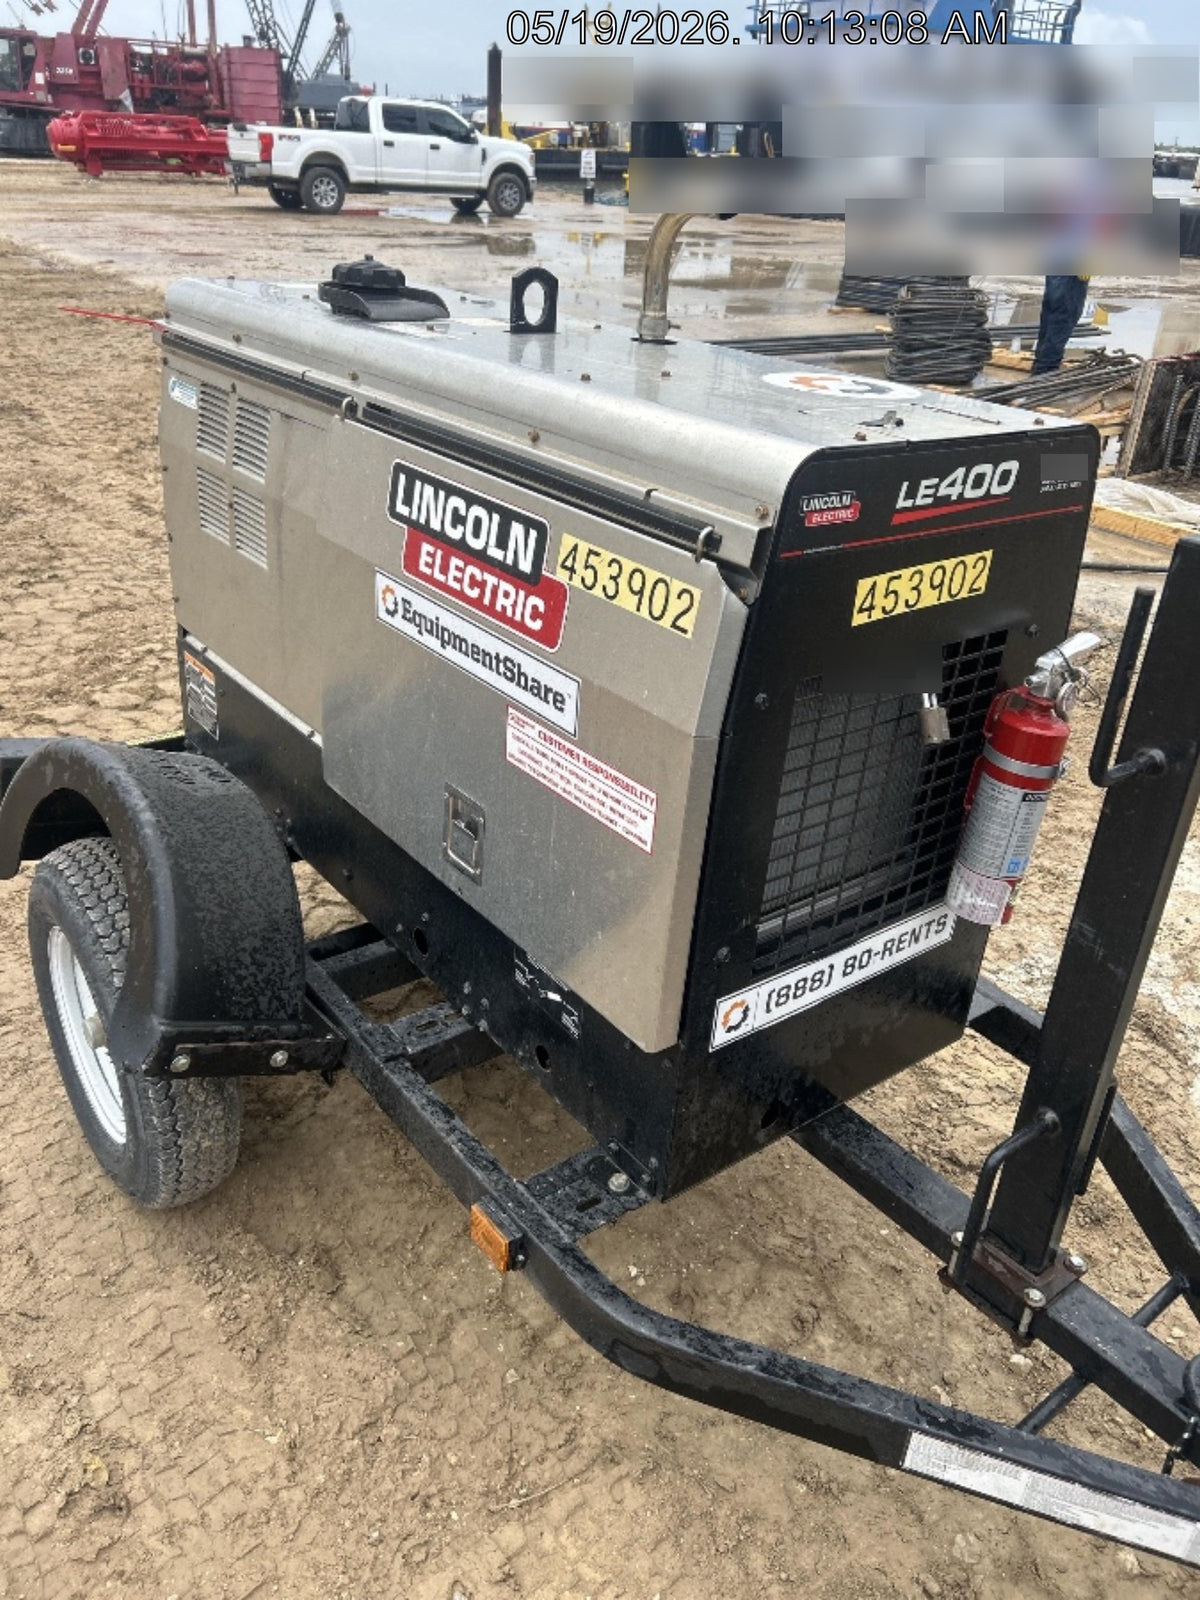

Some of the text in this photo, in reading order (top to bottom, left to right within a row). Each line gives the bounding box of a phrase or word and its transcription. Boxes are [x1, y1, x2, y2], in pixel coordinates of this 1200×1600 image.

[395, 473, 538, 574] LINCOLN
[803, 494, 851, 511] LINCOLN
[812, 509, 854, 524] ELECTRIC
[896, 460, 1019, 509] LE400
[418, 543, 546, 632] ELECTRIC
[559, 543, 695, 636] 453902
[856, 555, 988, 620] 453902
[401, 597, 568, 714] EquipmentShare
[537, 729, 580, 762] CUSTOMER
[583, 754, 655, 806] RESPONSIBILITY
[765, 913, 949, 1014] (888) 80-RENTS
